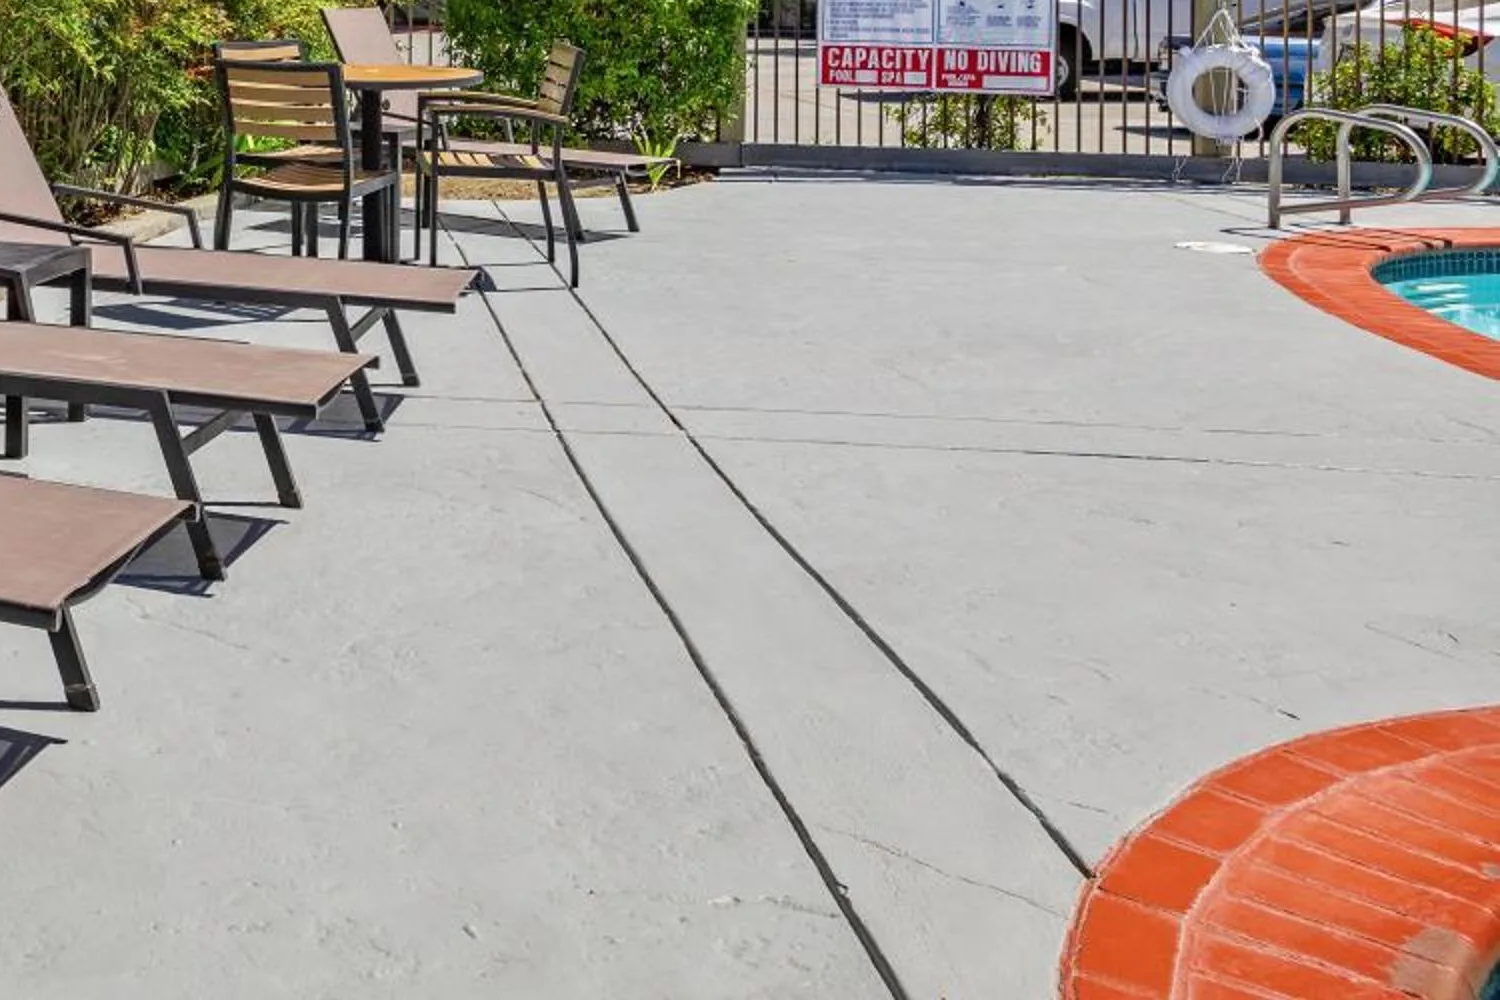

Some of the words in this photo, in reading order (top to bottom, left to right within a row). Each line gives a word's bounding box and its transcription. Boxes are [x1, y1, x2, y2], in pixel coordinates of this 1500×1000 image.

[828, 47, 930, 70] CAPACITY
[944, 49, 968, 71] NO
[977, 51, 1042, 73] DIVING
[829, 69, 852, 81] POOL
[881, 71, 902, 83] SPA
